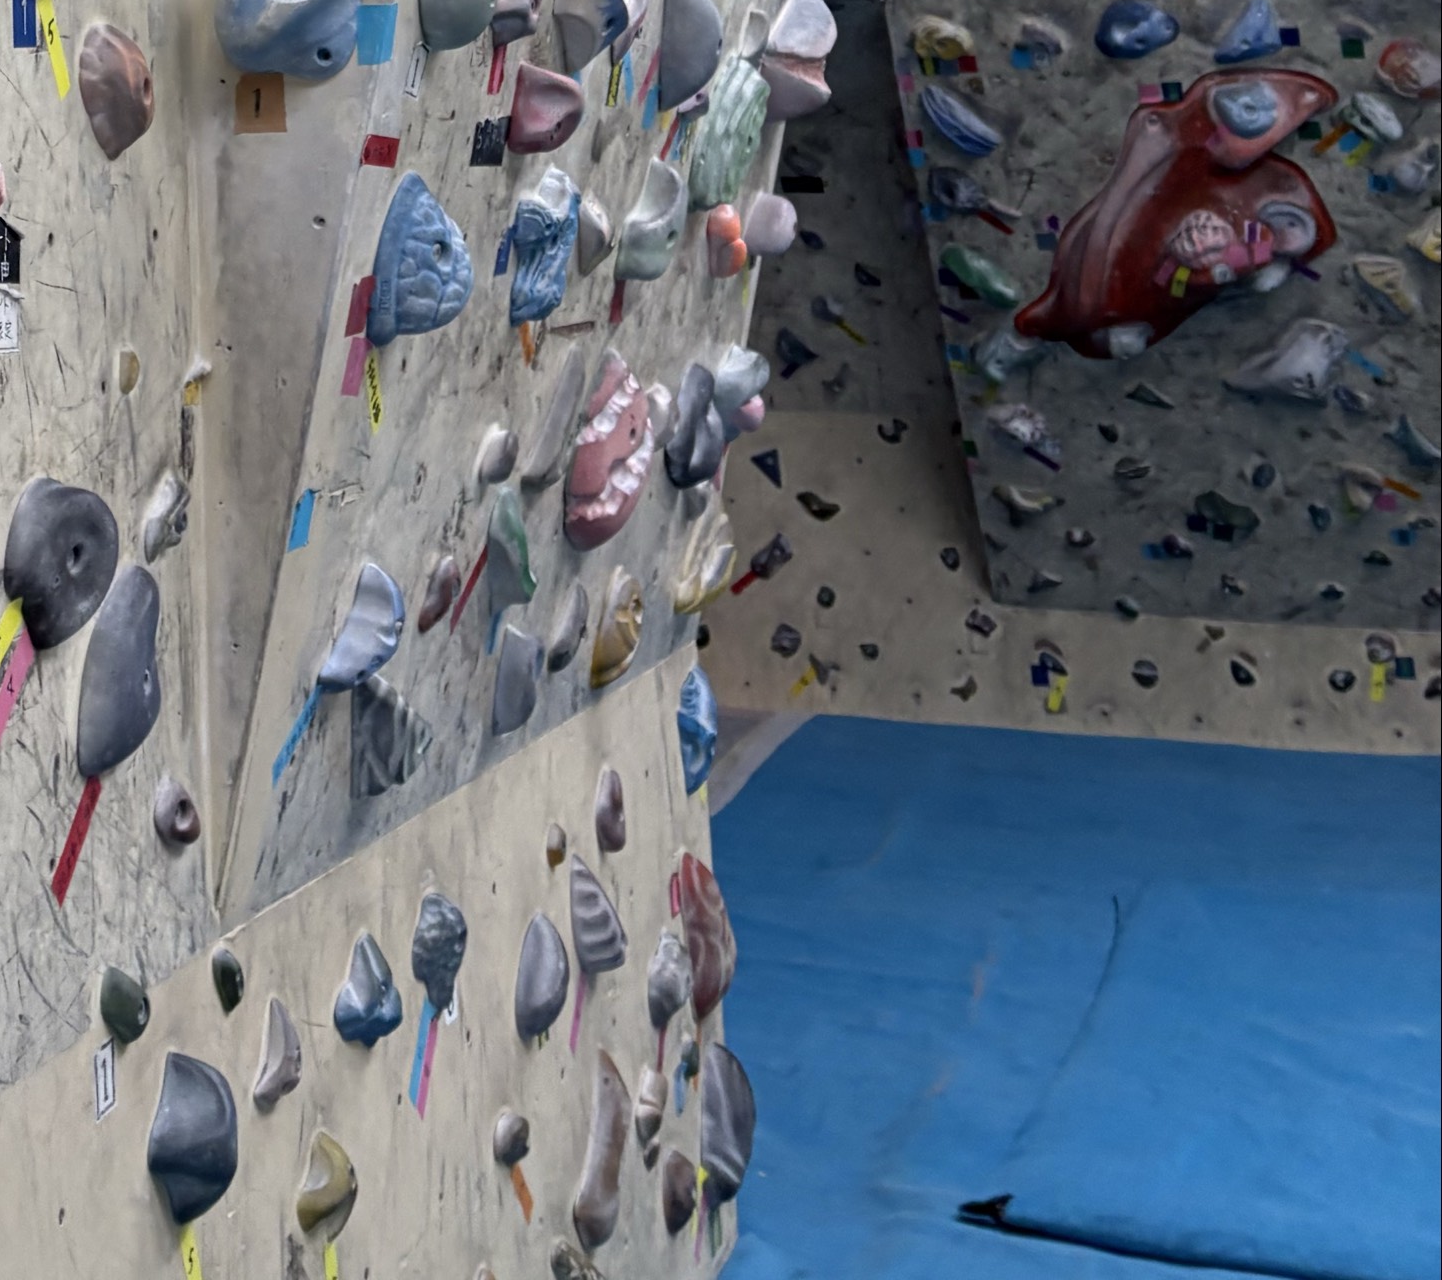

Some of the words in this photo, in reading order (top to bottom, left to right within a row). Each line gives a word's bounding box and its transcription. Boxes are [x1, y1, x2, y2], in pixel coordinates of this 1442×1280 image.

[48, 17, 55, 46] 5
[252, 87, 262, 118] 1
[101, 1057, 109, 1102] 1
